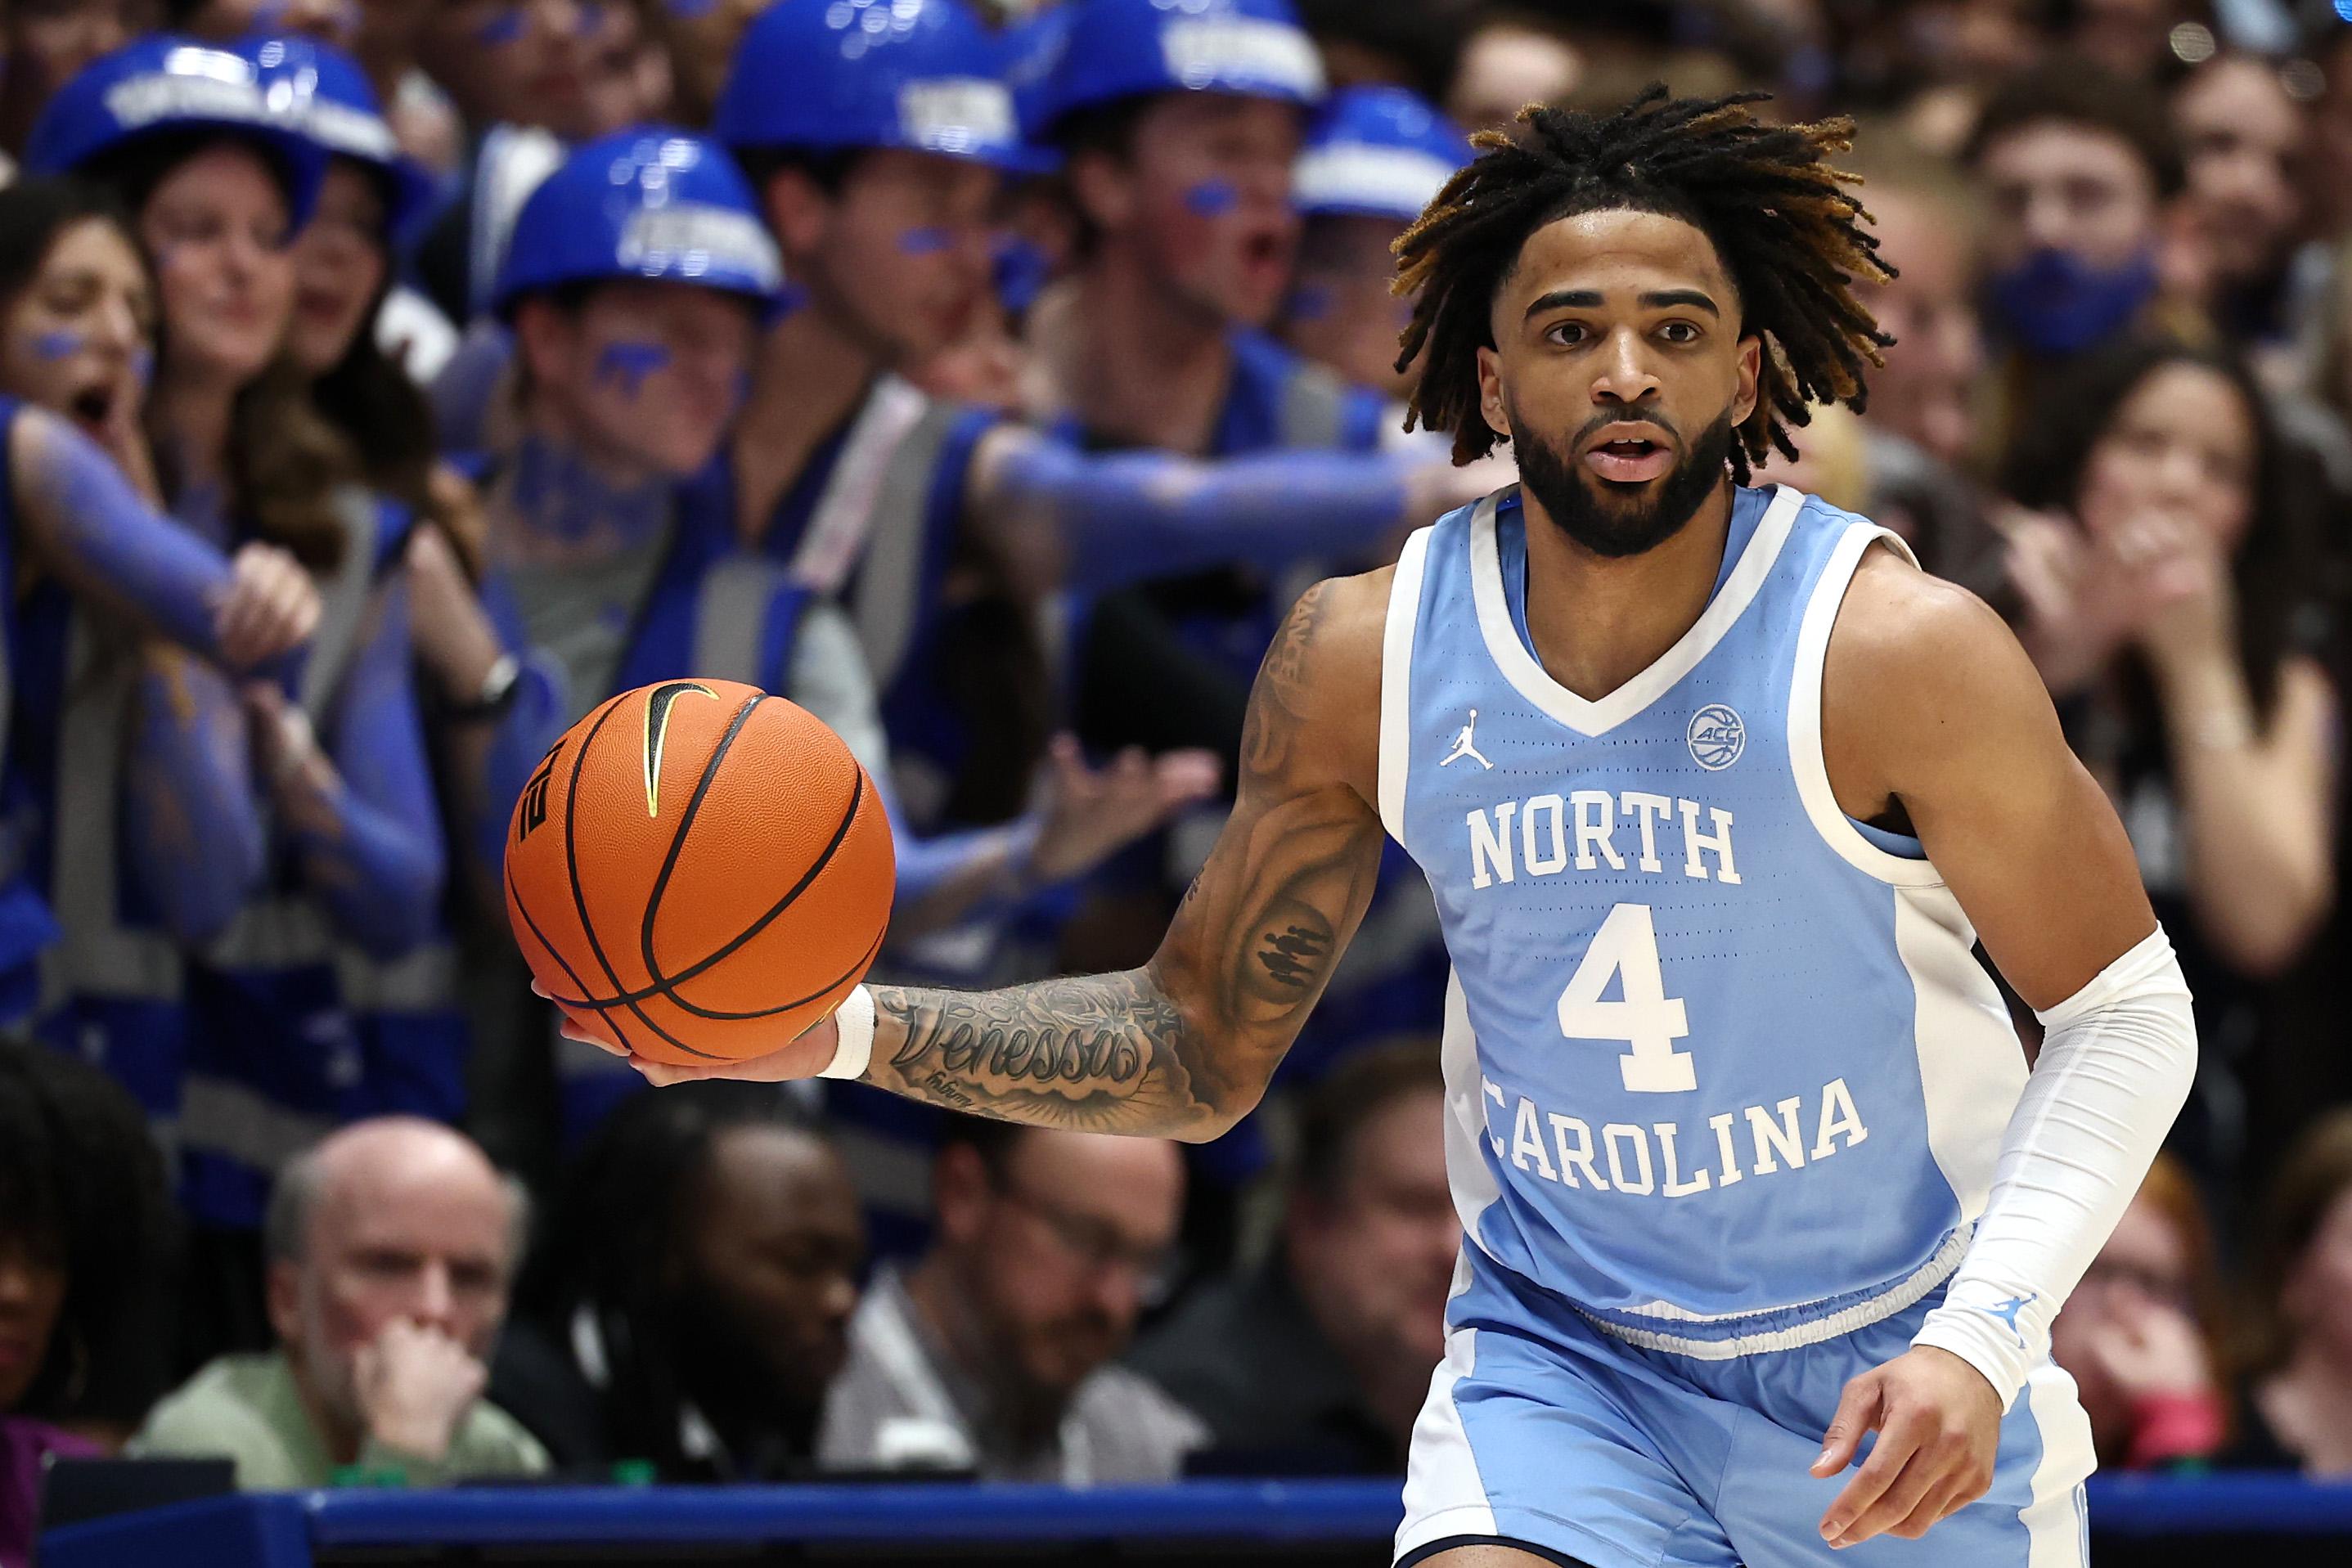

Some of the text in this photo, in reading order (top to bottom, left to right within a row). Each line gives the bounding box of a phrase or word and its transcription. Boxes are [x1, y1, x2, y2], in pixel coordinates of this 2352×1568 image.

[1694, 726, 1741, 744] ACC
[1466, 790, 1742, 890] NORTH
[1558, 903, 1698, 1093] 4
[1481, 1074, 1869, 1198] CAROLINA
